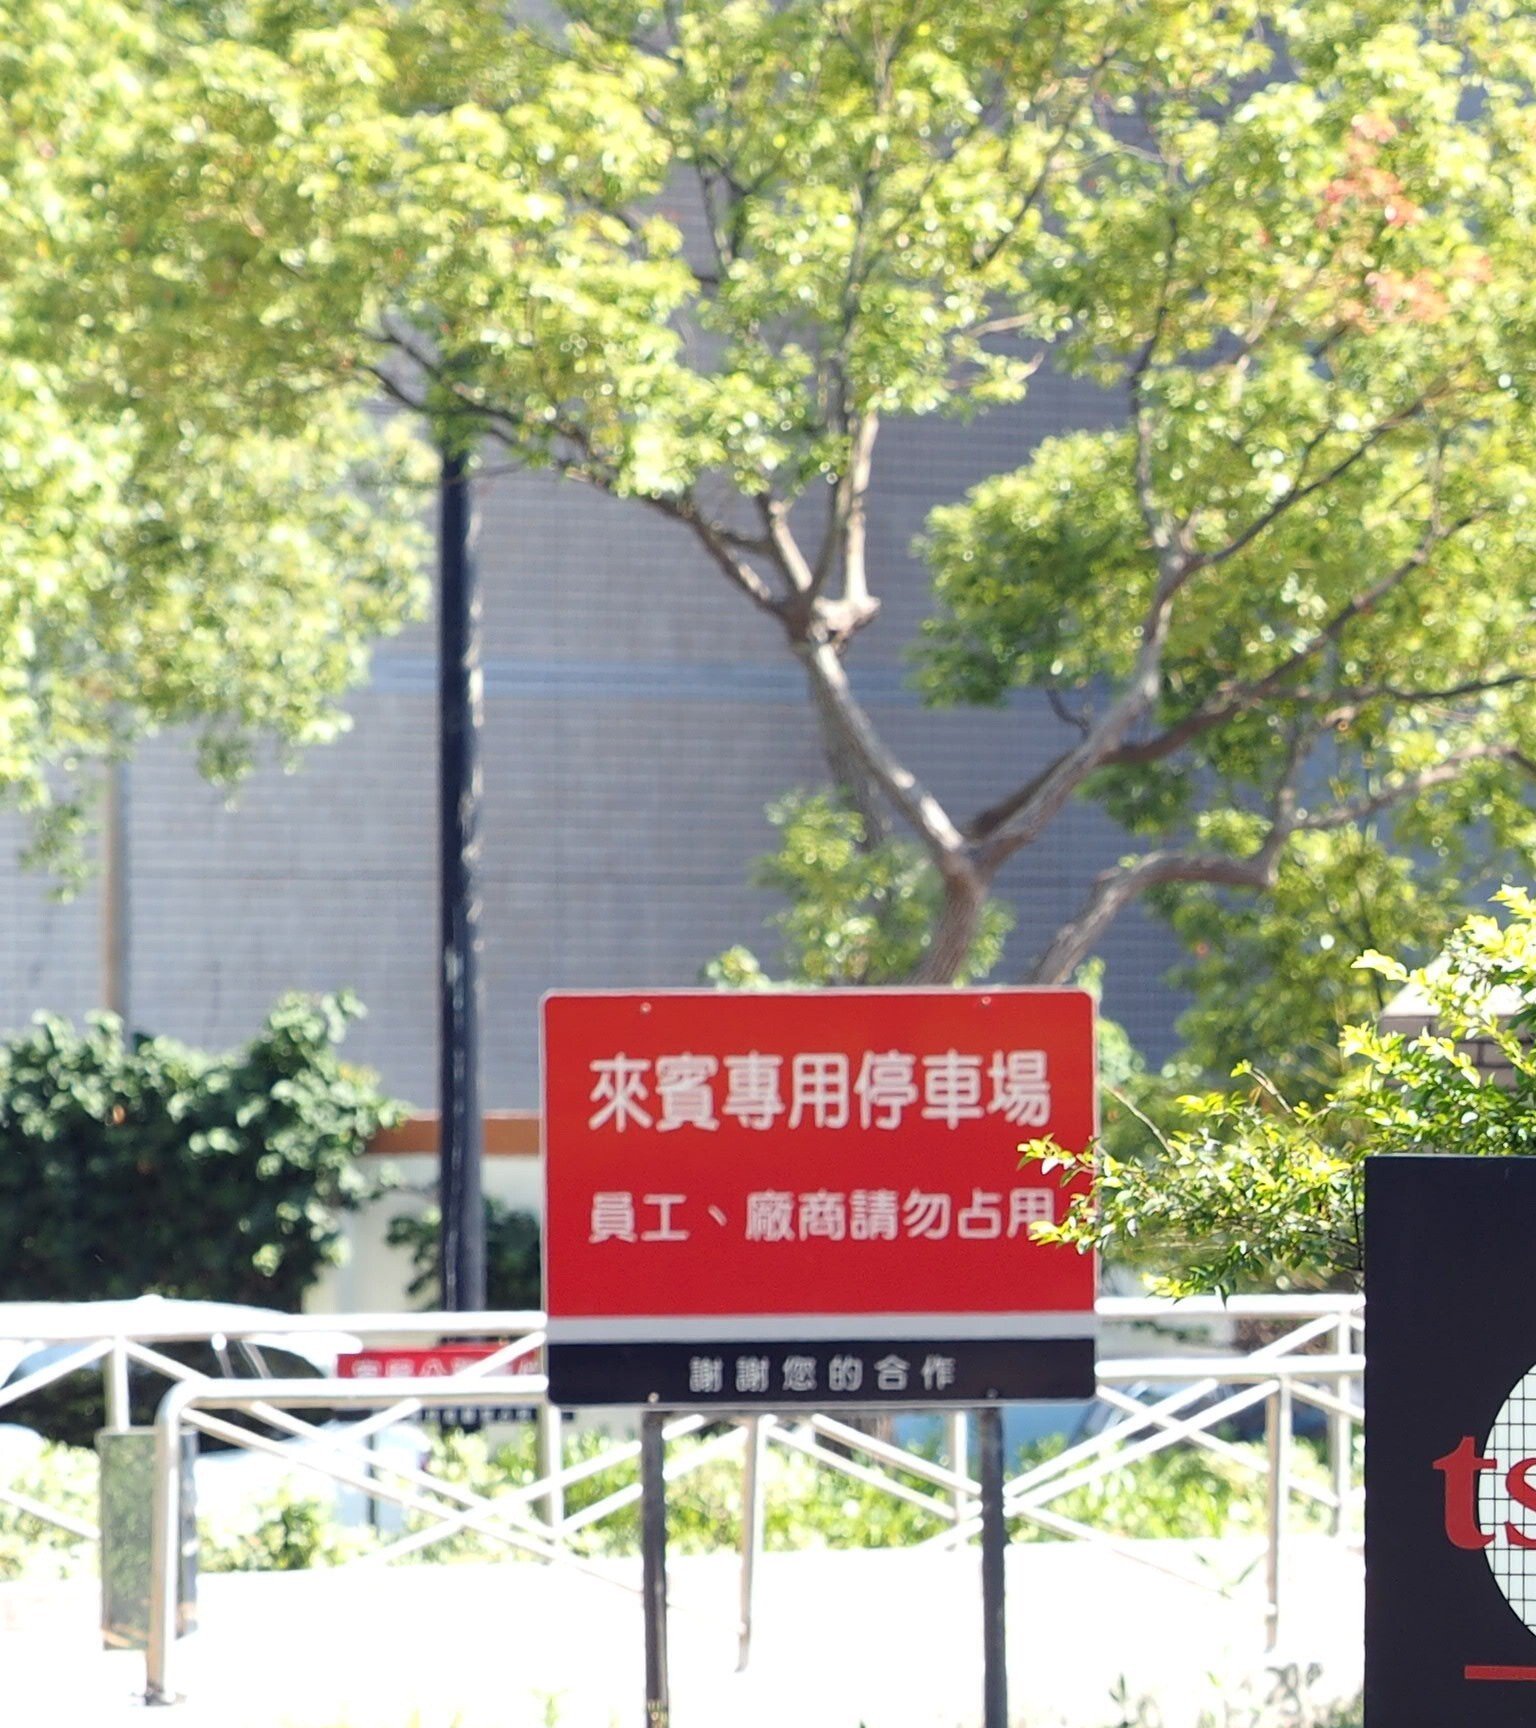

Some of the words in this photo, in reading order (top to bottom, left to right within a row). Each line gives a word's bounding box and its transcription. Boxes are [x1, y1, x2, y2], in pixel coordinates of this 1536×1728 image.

[588, 1049, 1053, 1134] 來賓專用停車場
[688, 1354, 957, 1393] 謝謝您的合作
